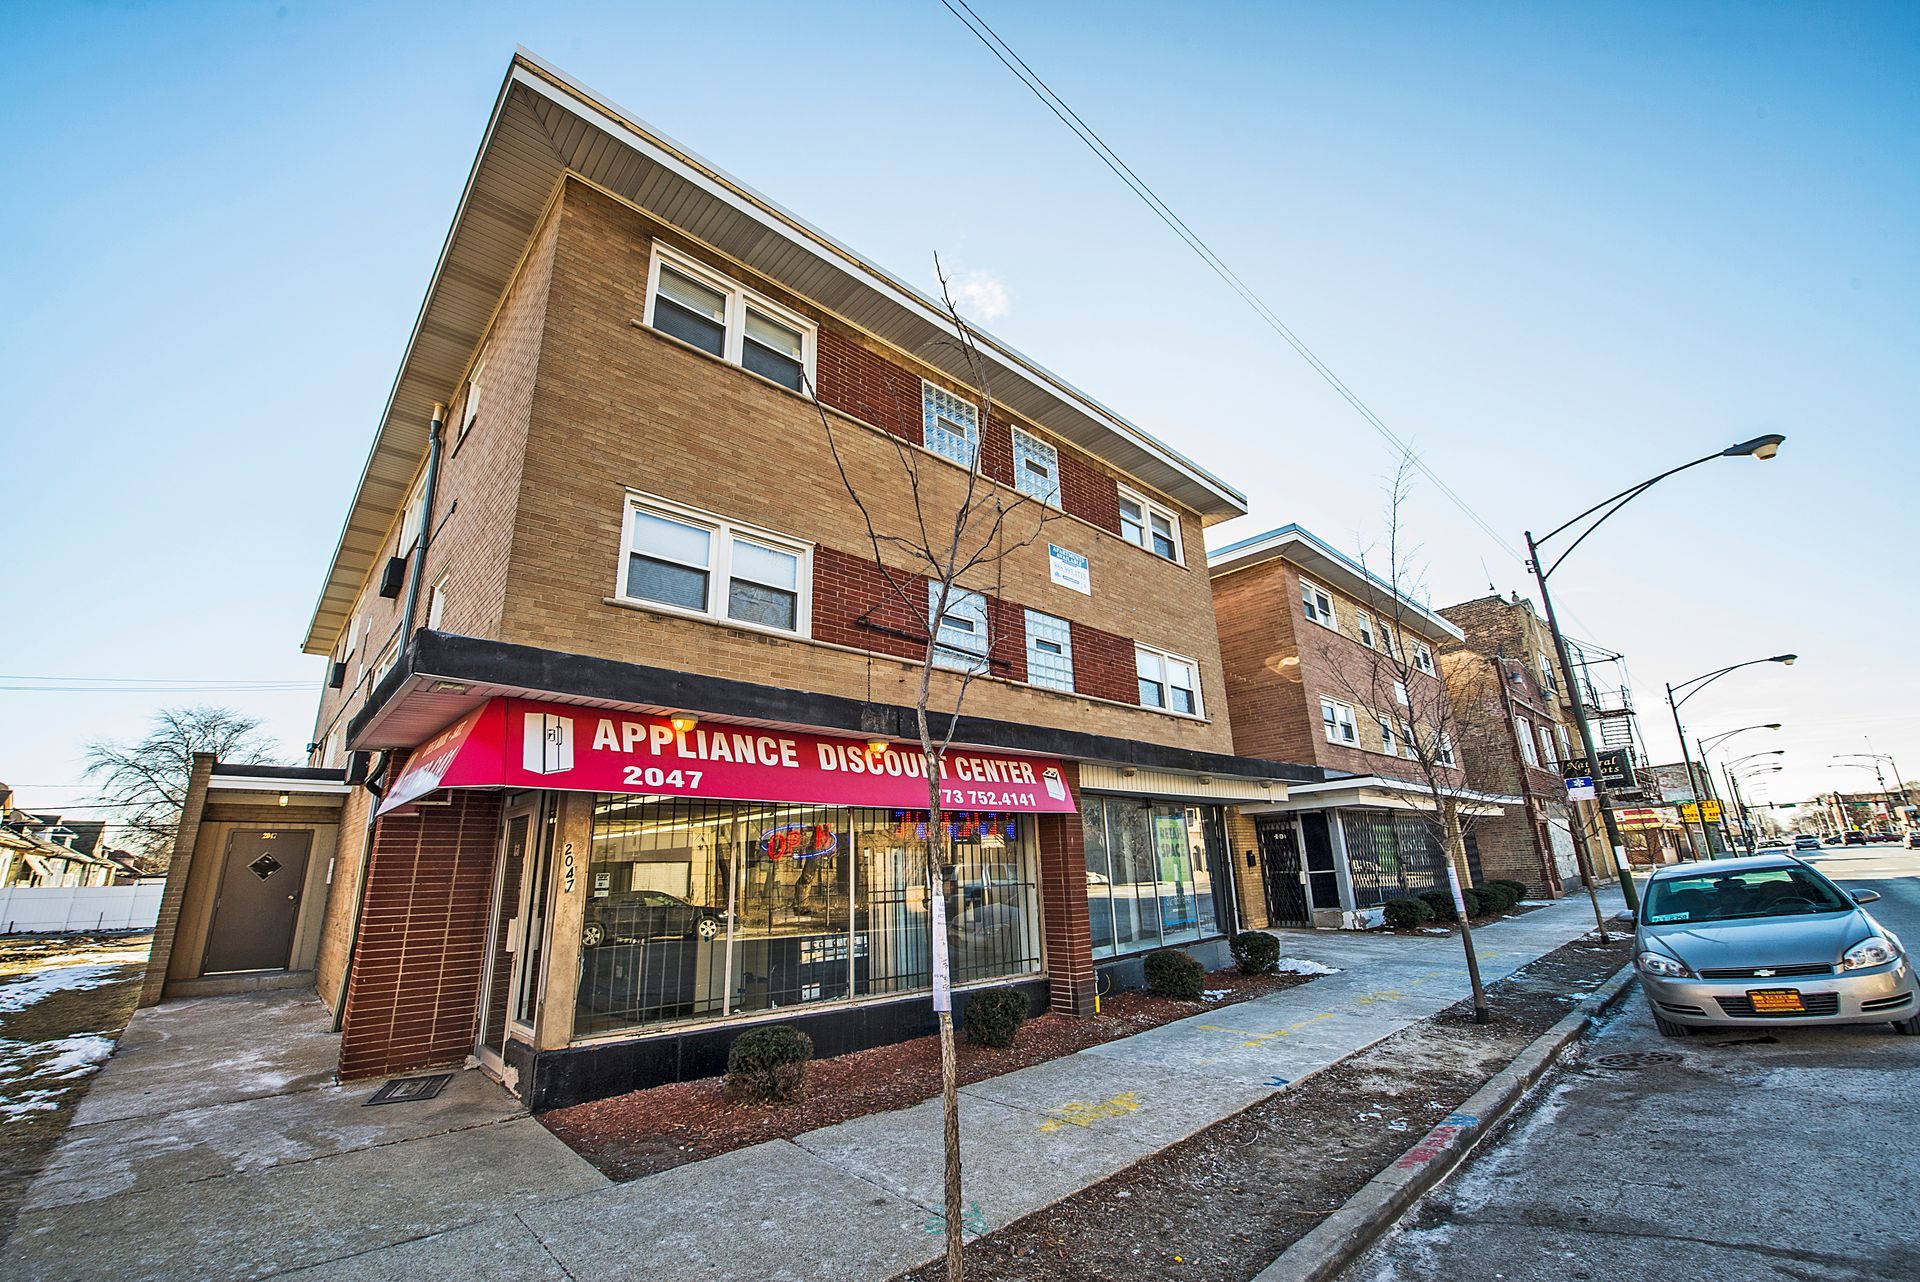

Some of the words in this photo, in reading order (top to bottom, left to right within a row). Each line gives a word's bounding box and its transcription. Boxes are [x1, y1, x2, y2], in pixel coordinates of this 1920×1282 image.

[592, 718, 799, 768] APPLIANCE
[955, 756, 1037, 785] CENTER
[1566, 755, 1617, 770] Natral
[623, 765, 703, 789] 2047
[938, 788, 964, 805] 73
[970, 790, 1037, 807] 752.4141
[767, 822, 831, 861] OPN
[1161, 843, 1186, 857] SPACE
[564, 843, 575, 894] 2047
